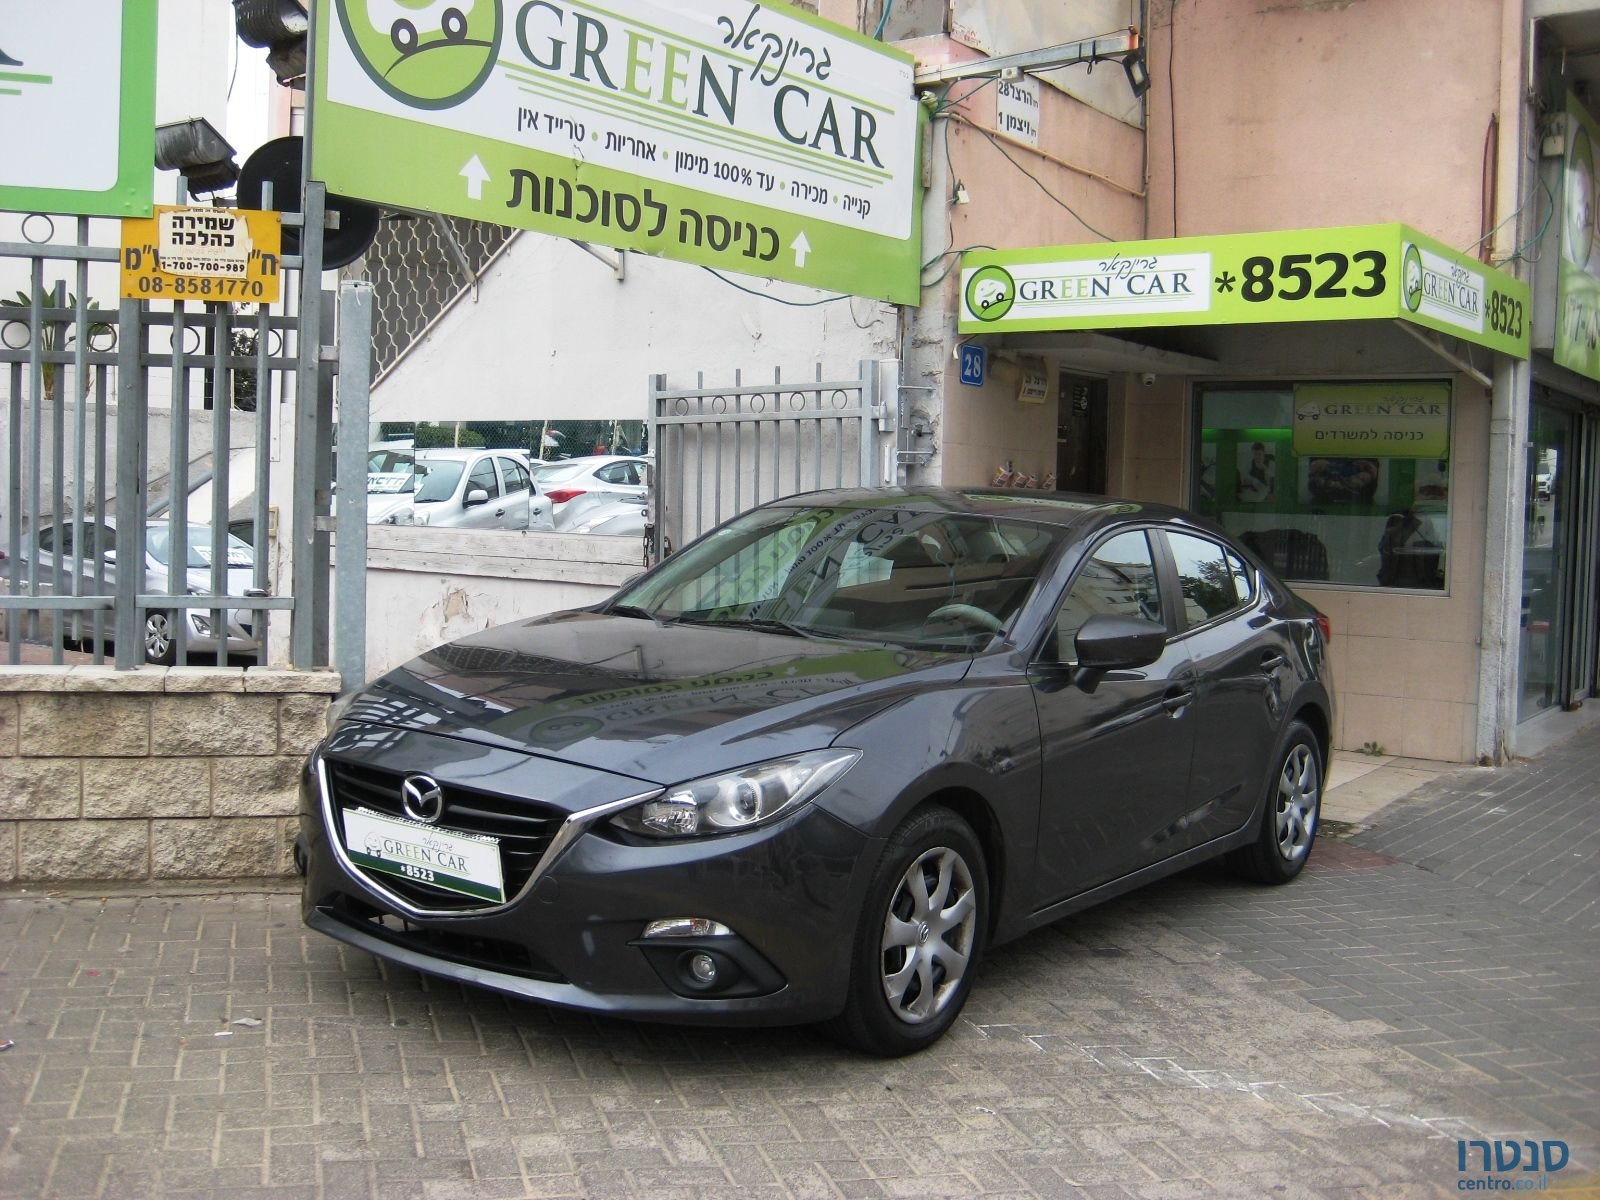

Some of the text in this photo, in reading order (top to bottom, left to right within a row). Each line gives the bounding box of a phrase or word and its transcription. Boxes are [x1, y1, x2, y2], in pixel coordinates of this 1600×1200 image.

[717, 3, 831, 86] גרינקאר
[515, 0, 885, 170] GREEN CAR
[998, 111, 1003, 125] 1
[1006, 114, 1030, 135] ויצמן
[517, 107, 872, 219] קנייה מכירה עד 100% מימון אחריות טרייד אין
[172, 215, 235, 231] שמירה
[505, 168, 780, 262] כניסה לסוכנות
[172, 231, 235, 248] כהלכה
[161, 261, 245, 273] 1-700-700-989
[138, 276, 263, 297] 08-8581770
[1019, 276, 1112, 301] GREEN
[1126, 272, 1192, 296] CAR
[1423, 272, 1456, 305] GREEN
[1459, 287, 1479, 313] CAR
[963, 353, 982, 378] 28
[1324, 404, 1441, 416] GREEN CAR
[1315, 428, 1425, 441] כניסה למשרדים
[383, 839, 468, 872] GREEN CAR
